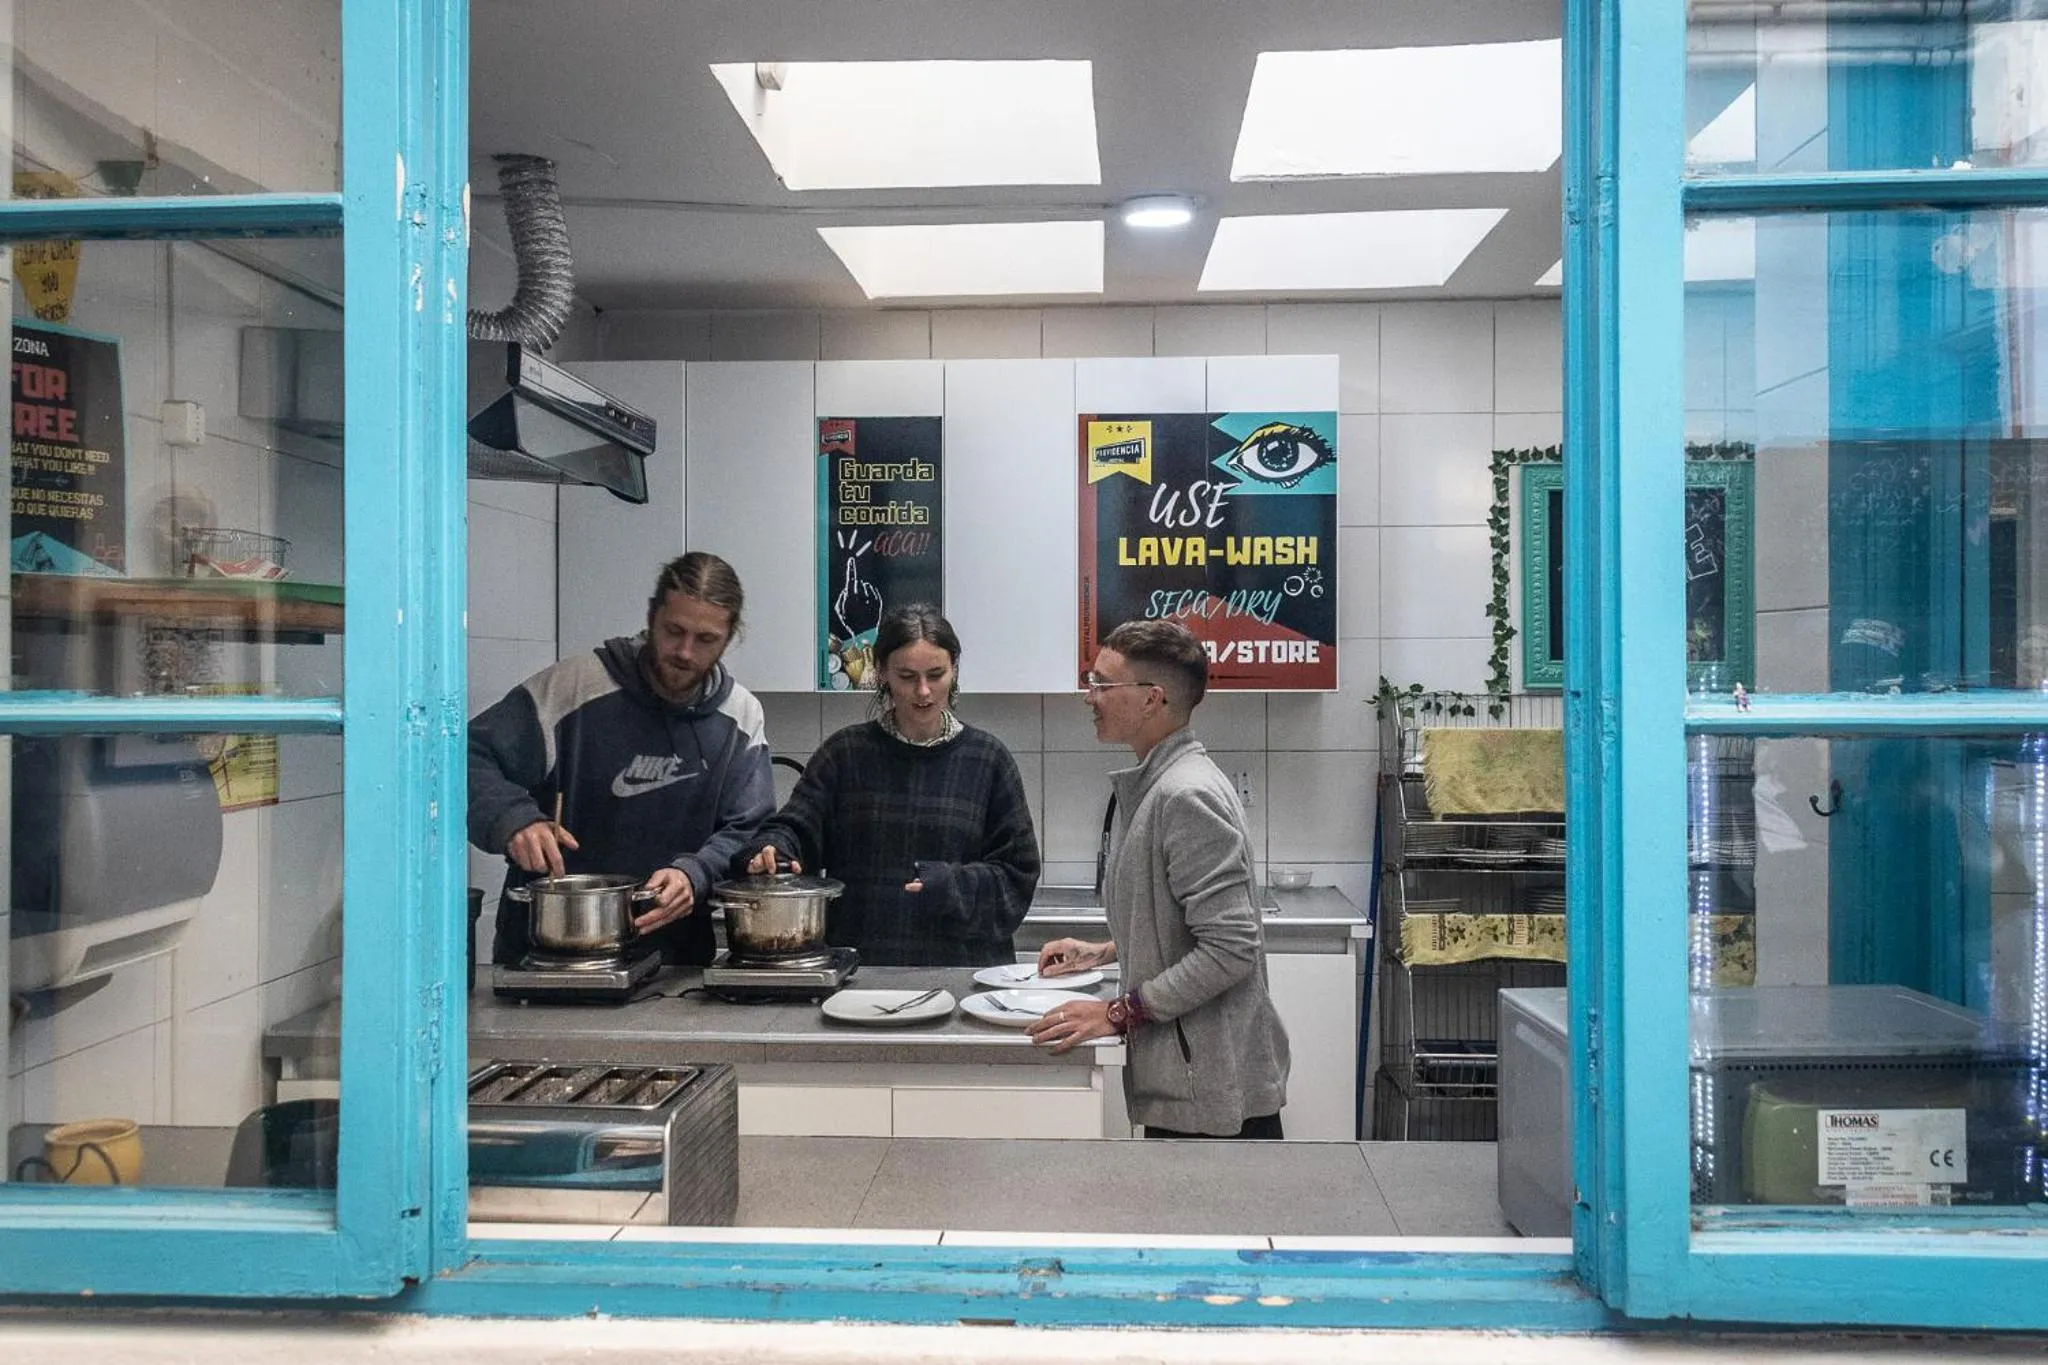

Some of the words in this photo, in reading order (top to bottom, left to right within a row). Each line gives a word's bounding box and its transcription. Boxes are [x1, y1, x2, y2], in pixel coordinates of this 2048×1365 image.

[13, 337, 50, 356] ZONA
[31, 444, 53, 457] YOU
[839, 457, 935, 481] Guarda
[839, 481, 870, 503] tu
[27, 502, 47, 516] QUE
[839, 501, 929, 524] comida
[1149, 480, 1241, 528] USE
[1118, 536, 1319, 566] LAVA-WASH
[625, 754, 683, 780] NIKE
[1829, 1114, 1879, 1129] THOMAS
